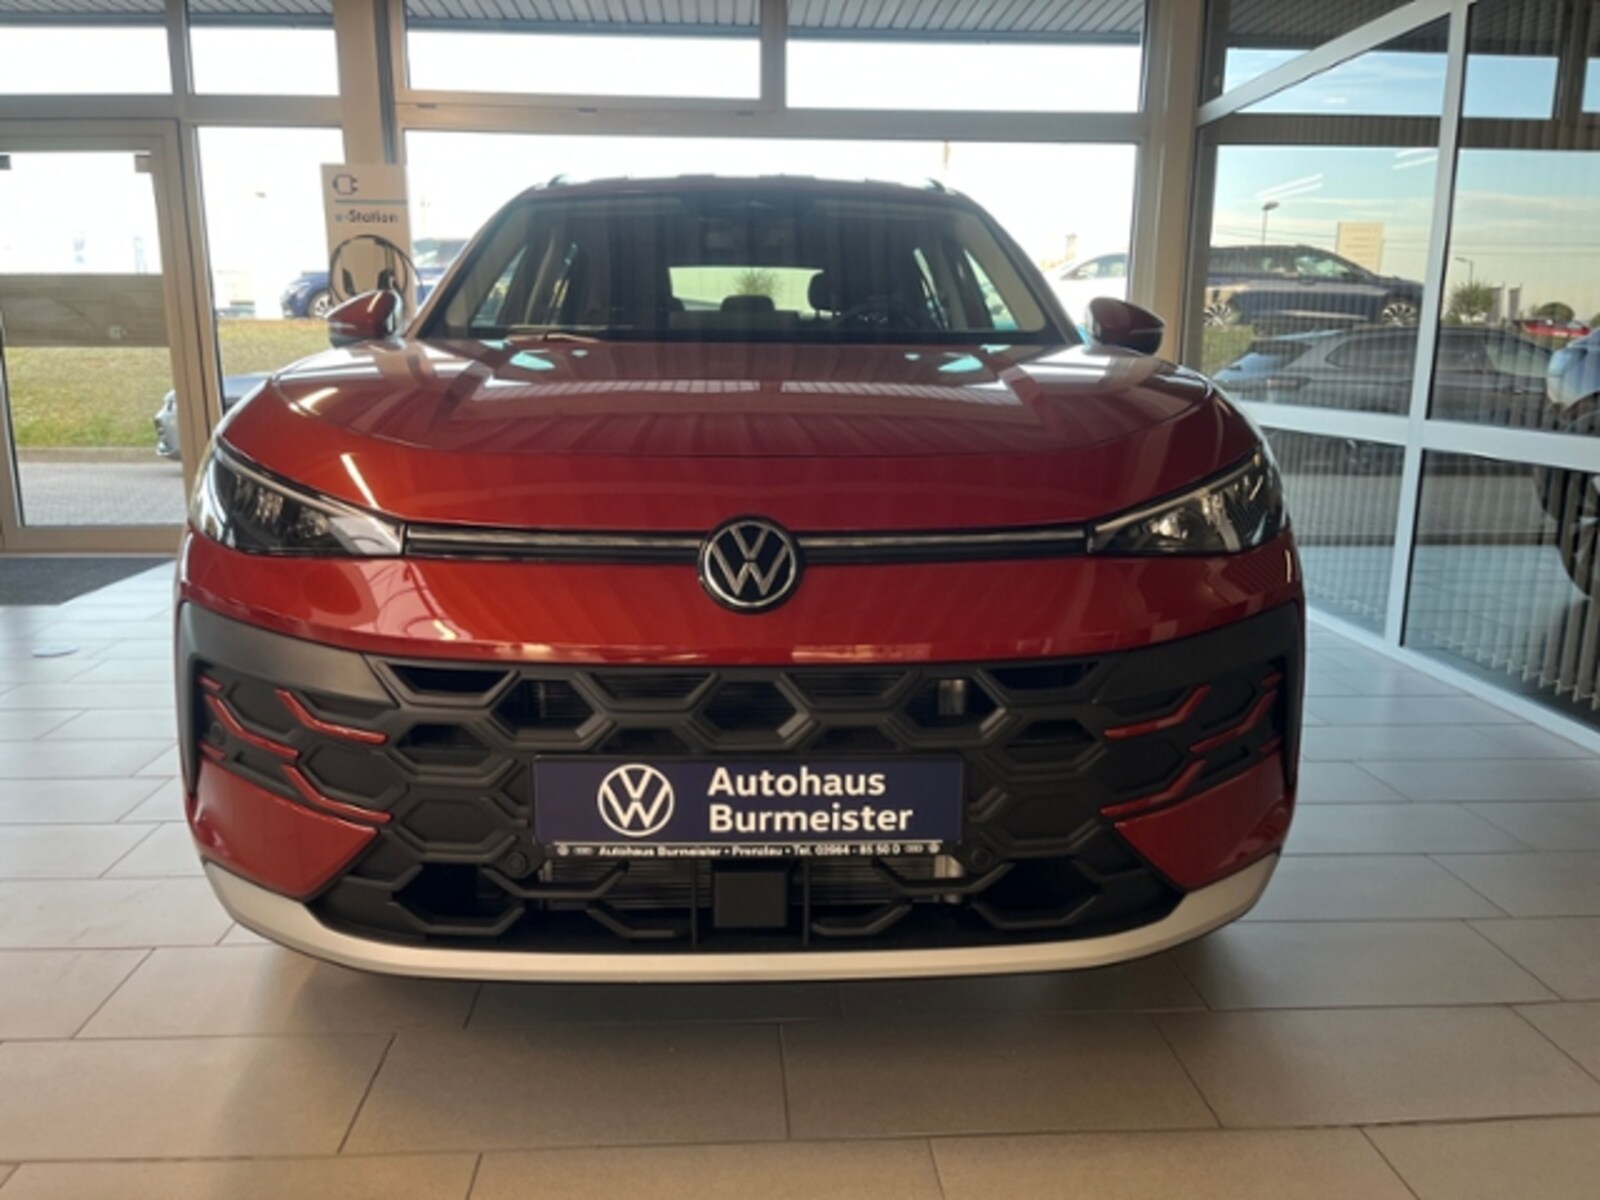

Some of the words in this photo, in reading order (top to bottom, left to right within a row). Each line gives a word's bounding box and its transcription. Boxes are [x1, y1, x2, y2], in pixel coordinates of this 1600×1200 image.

[707, 766, 886, 796] Autohaus
[709, 803, 913, 832] Burmeister
[599, 845, 654, 857] Autohaus
[657, 845, 720, 857] Burmeister
